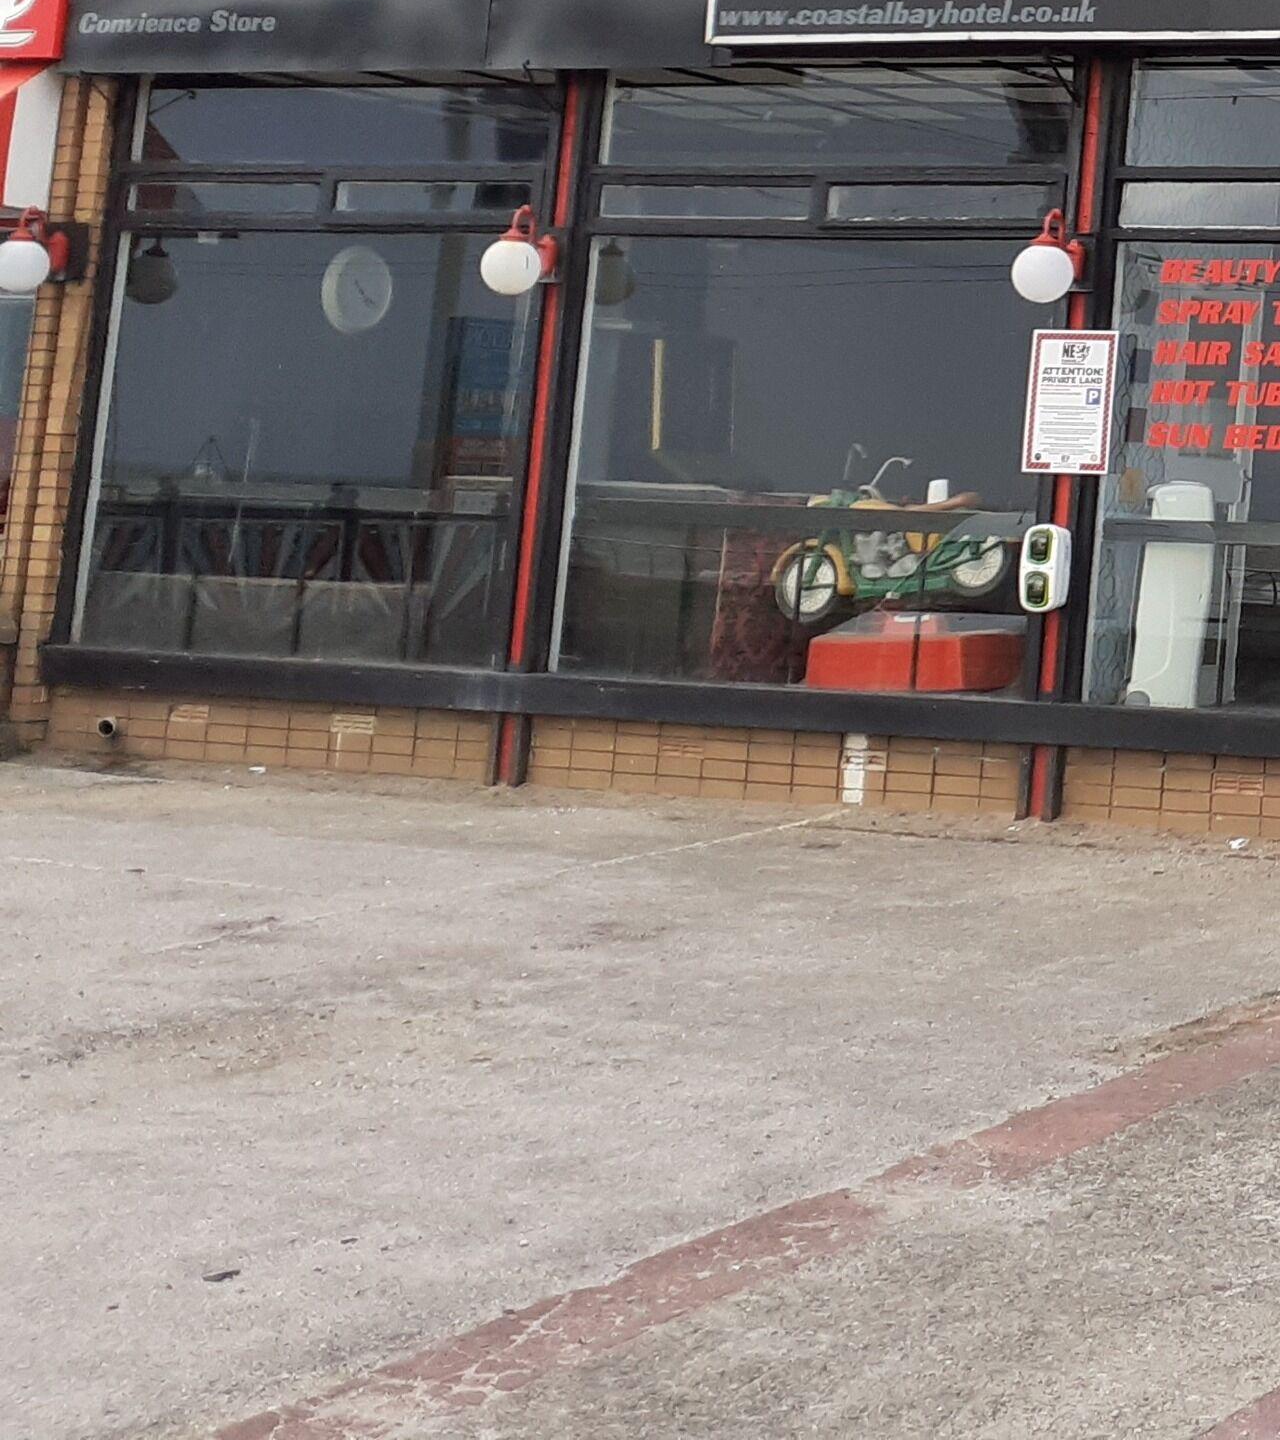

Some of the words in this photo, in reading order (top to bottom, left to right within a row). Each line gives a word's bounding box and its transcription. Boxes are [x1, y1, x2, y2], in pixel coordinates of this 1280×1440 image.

[79, 10, 200, 35] Convience
[211, 9, 275, 33] Store
[1157, 301, 1259, 326] SPRAY
[1153, 341, 1231, 366] HAIR
[1041, 376, 1076, 384] PRIVATE
[1079, 377, 1103, 385] LAND
[1088, 390, 1099, 403] P
[1150, 381, 1214, 406] HOT
[1148, 423, 1211, 448] SUN
